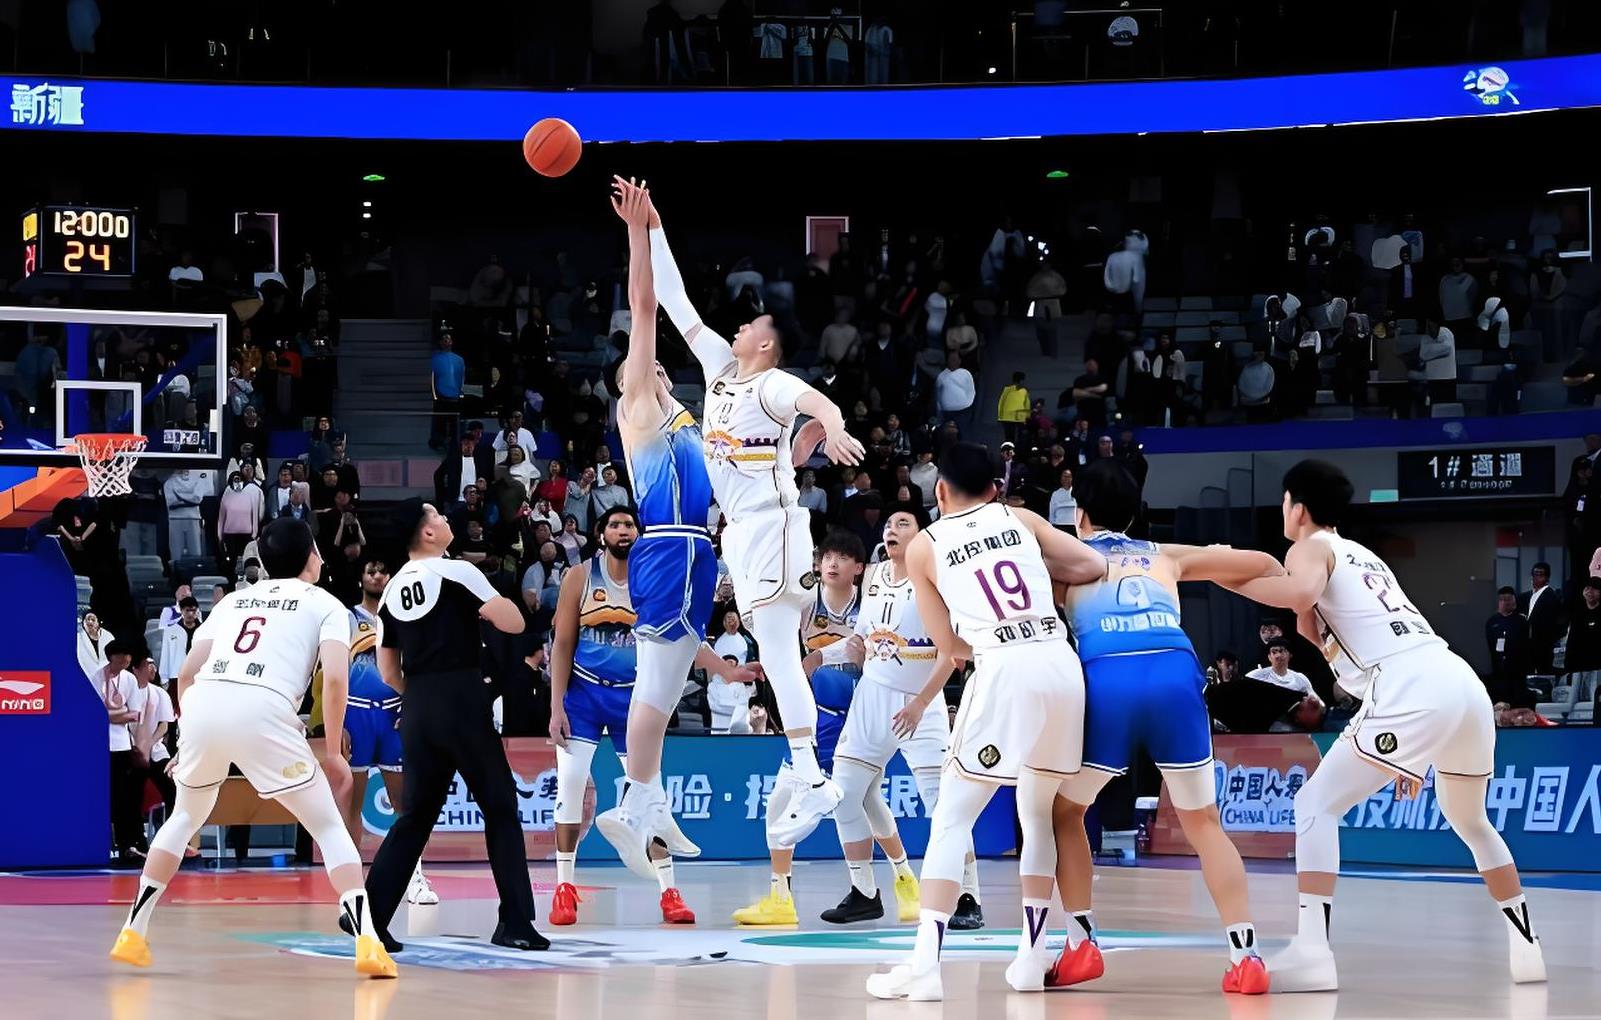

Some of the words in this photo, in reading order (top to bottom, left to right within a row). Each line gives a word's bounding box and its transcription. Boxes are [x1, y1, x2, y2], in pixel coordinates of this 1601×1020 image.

[64, 241, 110, 272] 24
[401, 581, 426, 611] 80
[974, 560, 1032, 622] 19
[233, 616, 266, 654] 6
